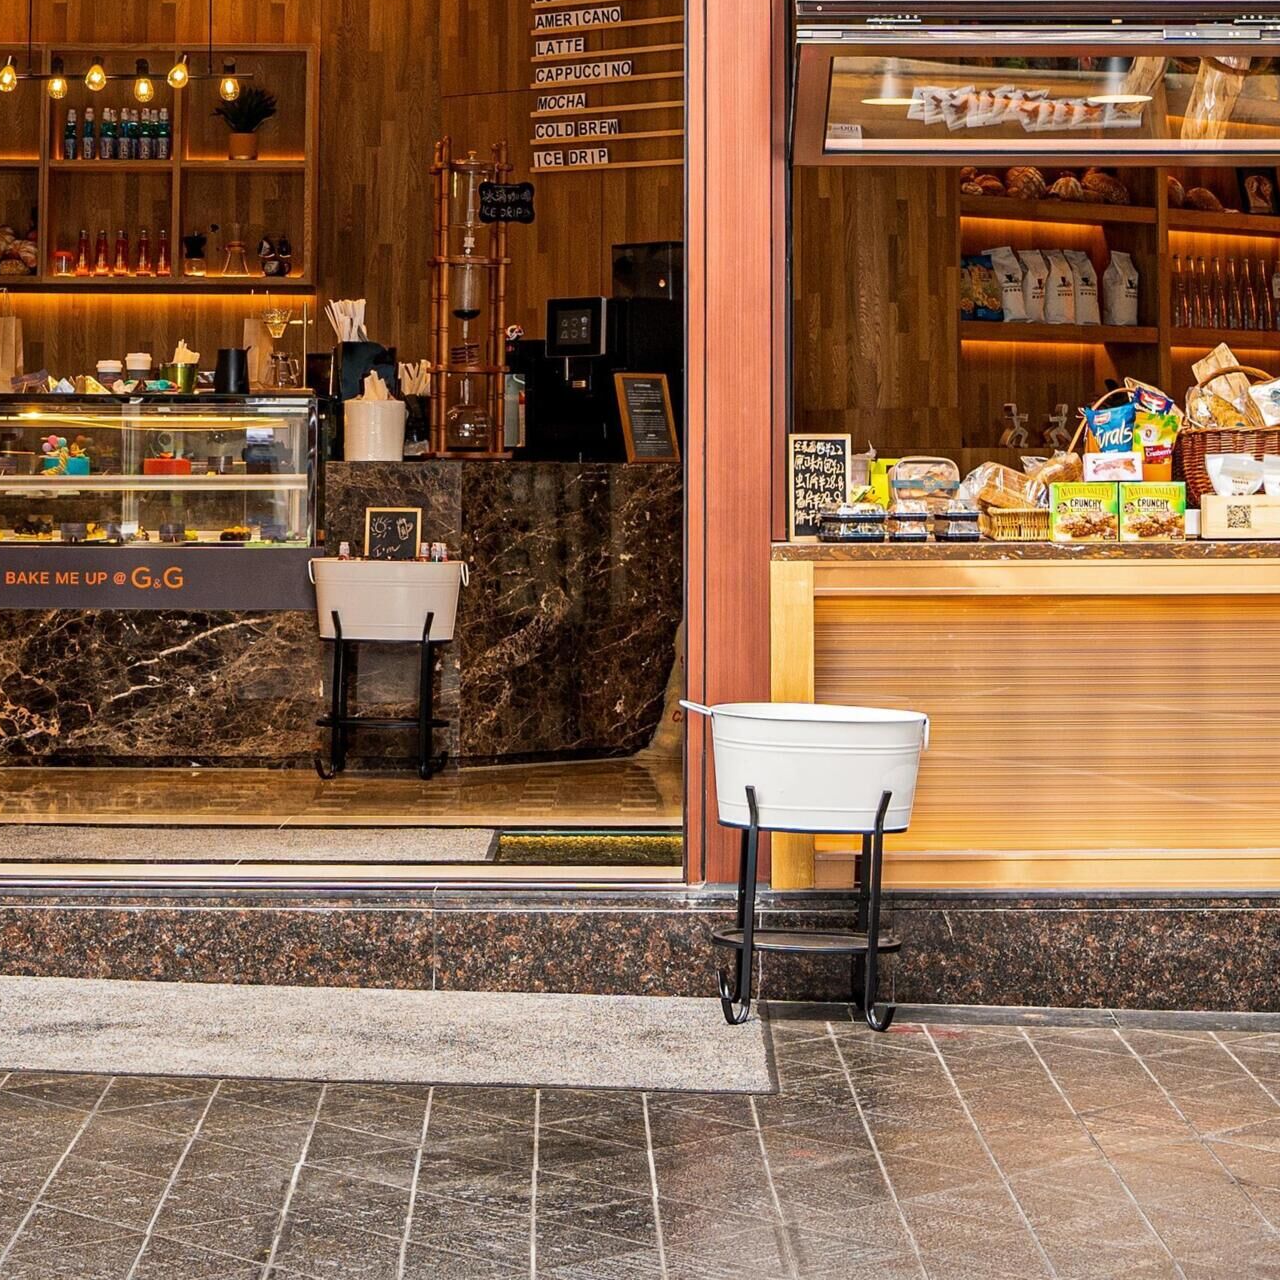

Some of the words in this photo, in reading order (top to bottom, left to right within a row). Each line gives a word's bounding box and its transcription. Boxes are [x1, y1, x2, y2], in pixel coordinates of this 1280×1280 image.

[536, 9, 620, 29] AMERICANO
[537, 39, 582, 55] LATTE
[536, 62, 631, 82] CAPPUCCINO
[538, 95, 585, 110] MOCHA
[536, 123, 573, 138] COLD
[580, 120, 618, 135] BREW
[537, 152, 562, 166] ICE
[570, 149, 606, 164] DRIP
[1070, 498, 1102, 511] CRUNCHY
[1137, 498, 1170, 511] CRUNCHY
[5, 571, 49, 585] BAKE
[55, 571, 80, 585] ME
[85, 571, 108, 585] UP
[113, 571, 127, 585] @
